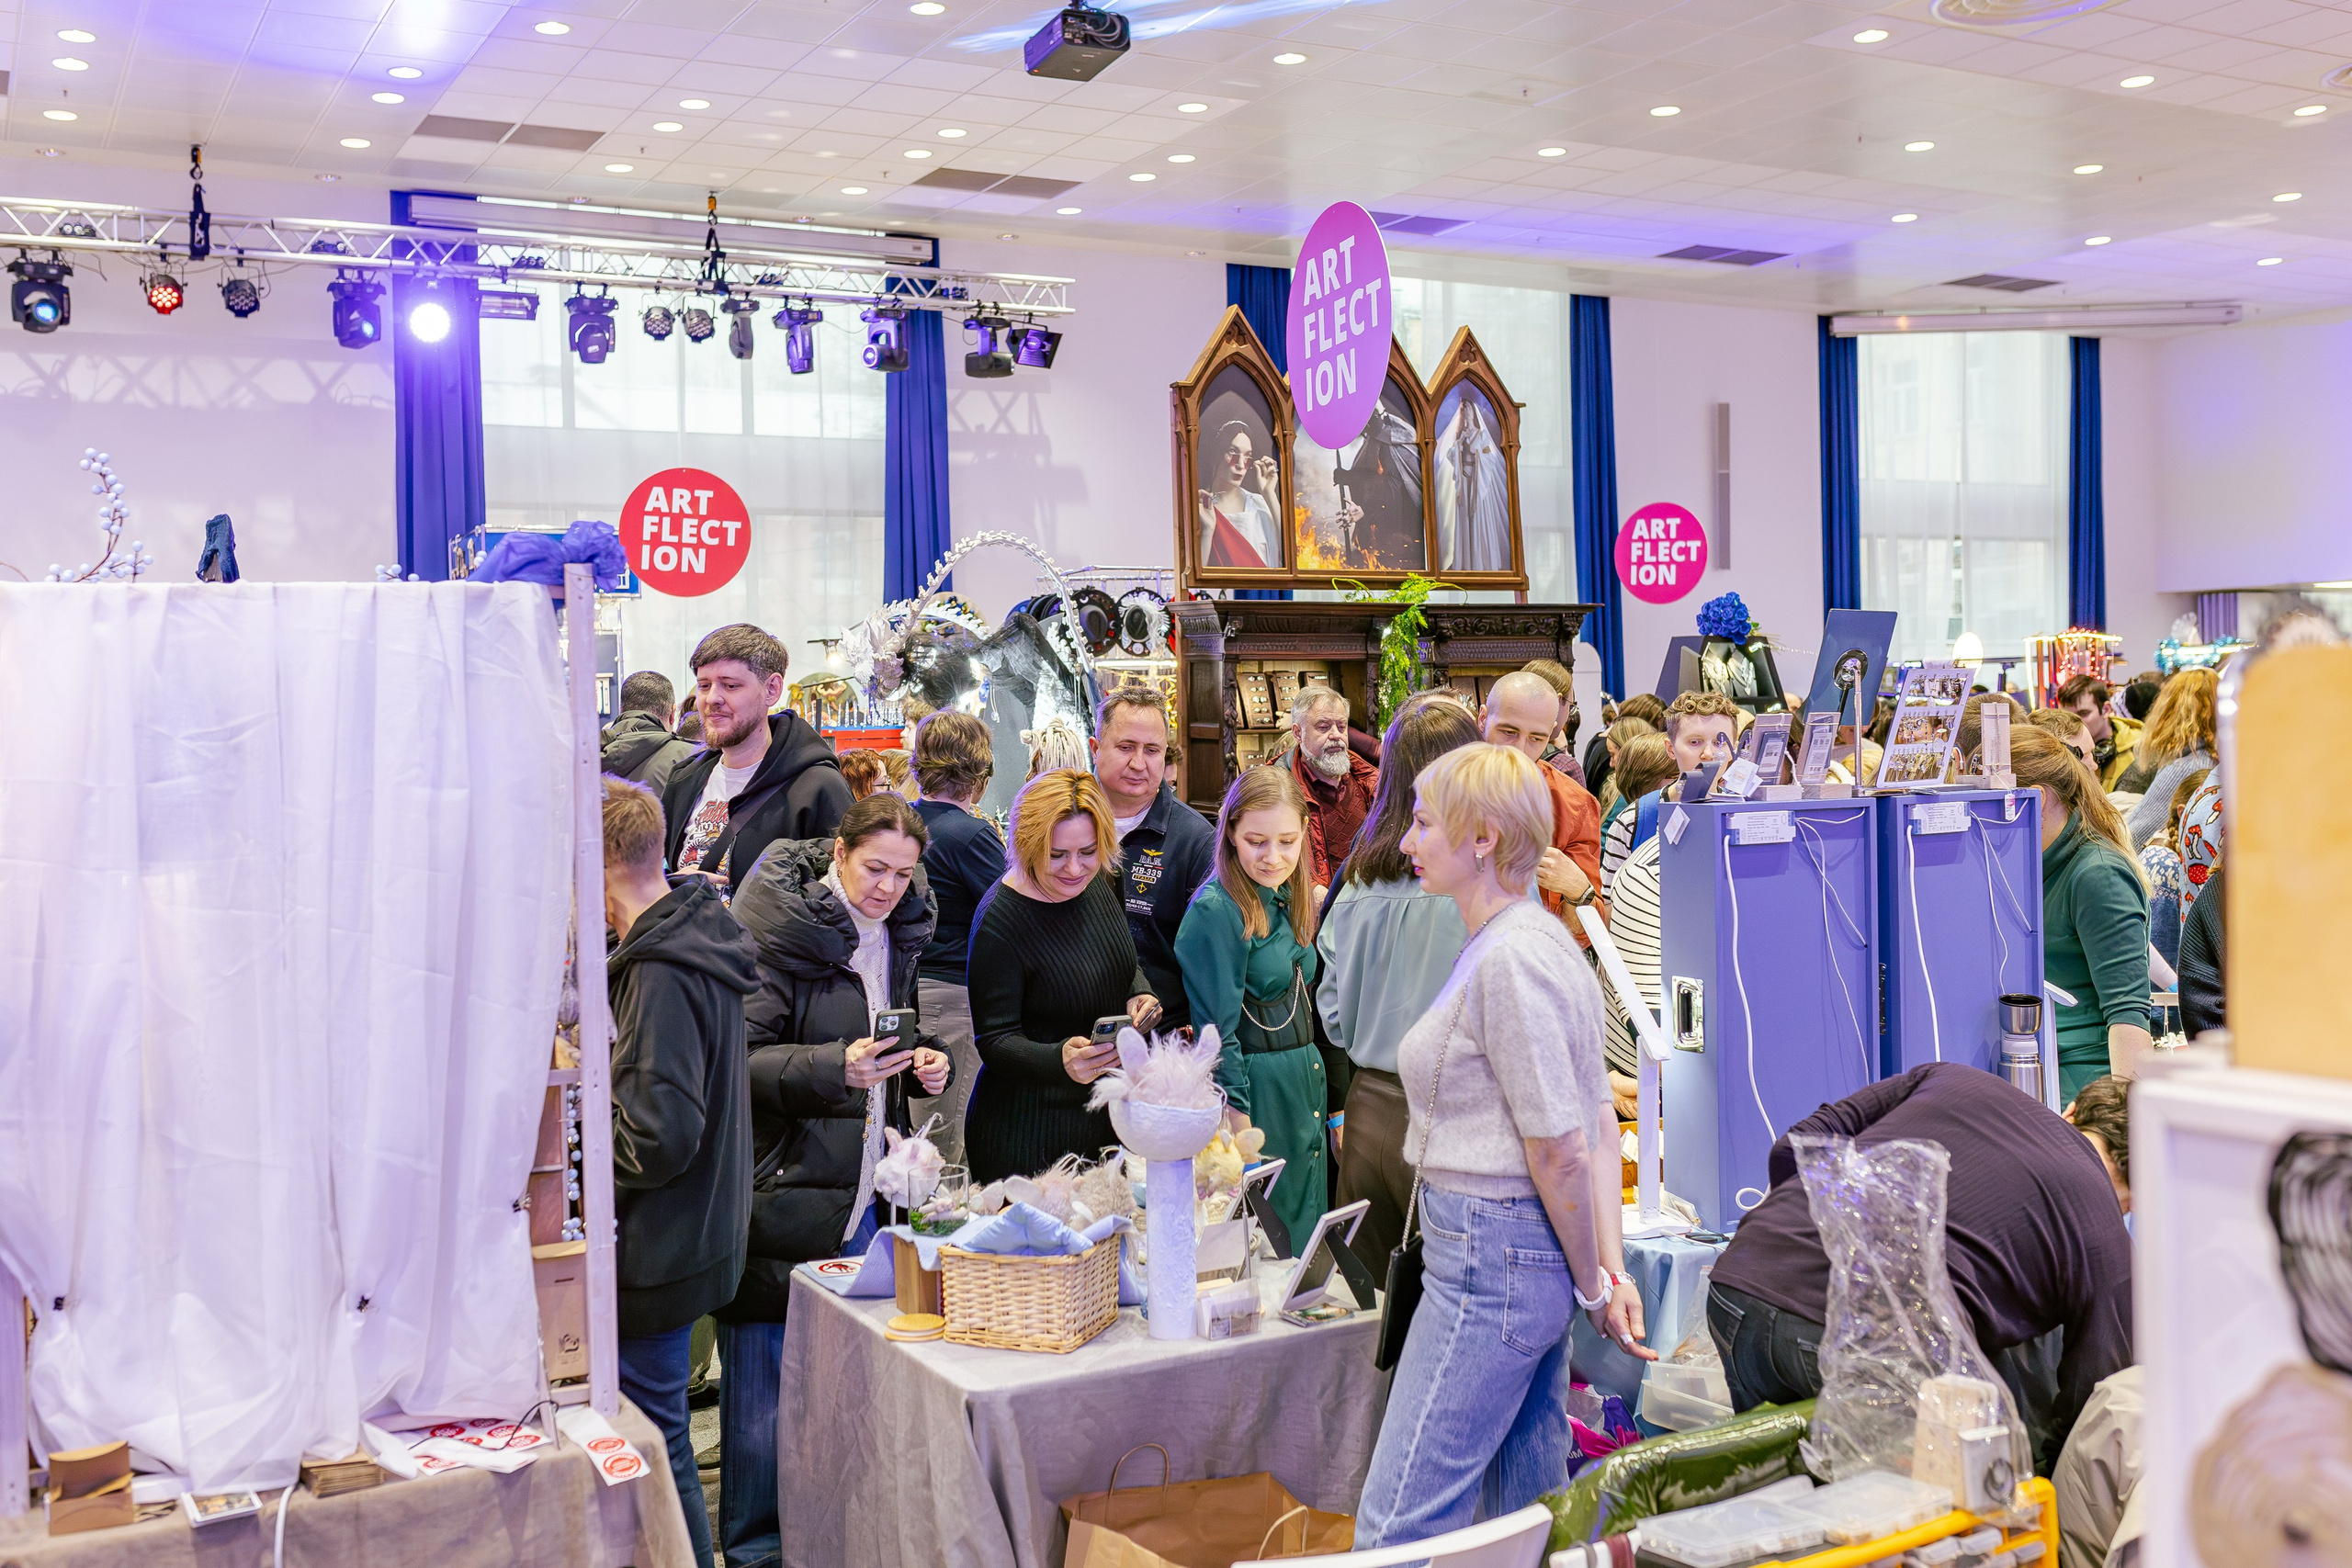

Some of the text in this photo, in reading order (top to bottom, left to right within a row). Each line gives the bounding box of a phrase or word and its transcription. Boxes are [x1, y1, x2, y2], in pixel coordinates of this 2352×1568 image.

[1303, 234, 1355, 307] ART
[1304, 277, 1381, 359] FLECT
[1306, 348, 1357, 412] ION
[644, 486, 714, 514] ART
[643, 515, 741, 547] FLECT
[1632, 518, 1680, 540] ART
[641, 544, 707, 573] ION
[1631, 540, 1701, 563] FLECT
[1630, 564, 1677, 585] ION
[1131, 866, 1162, 878] MB-339
